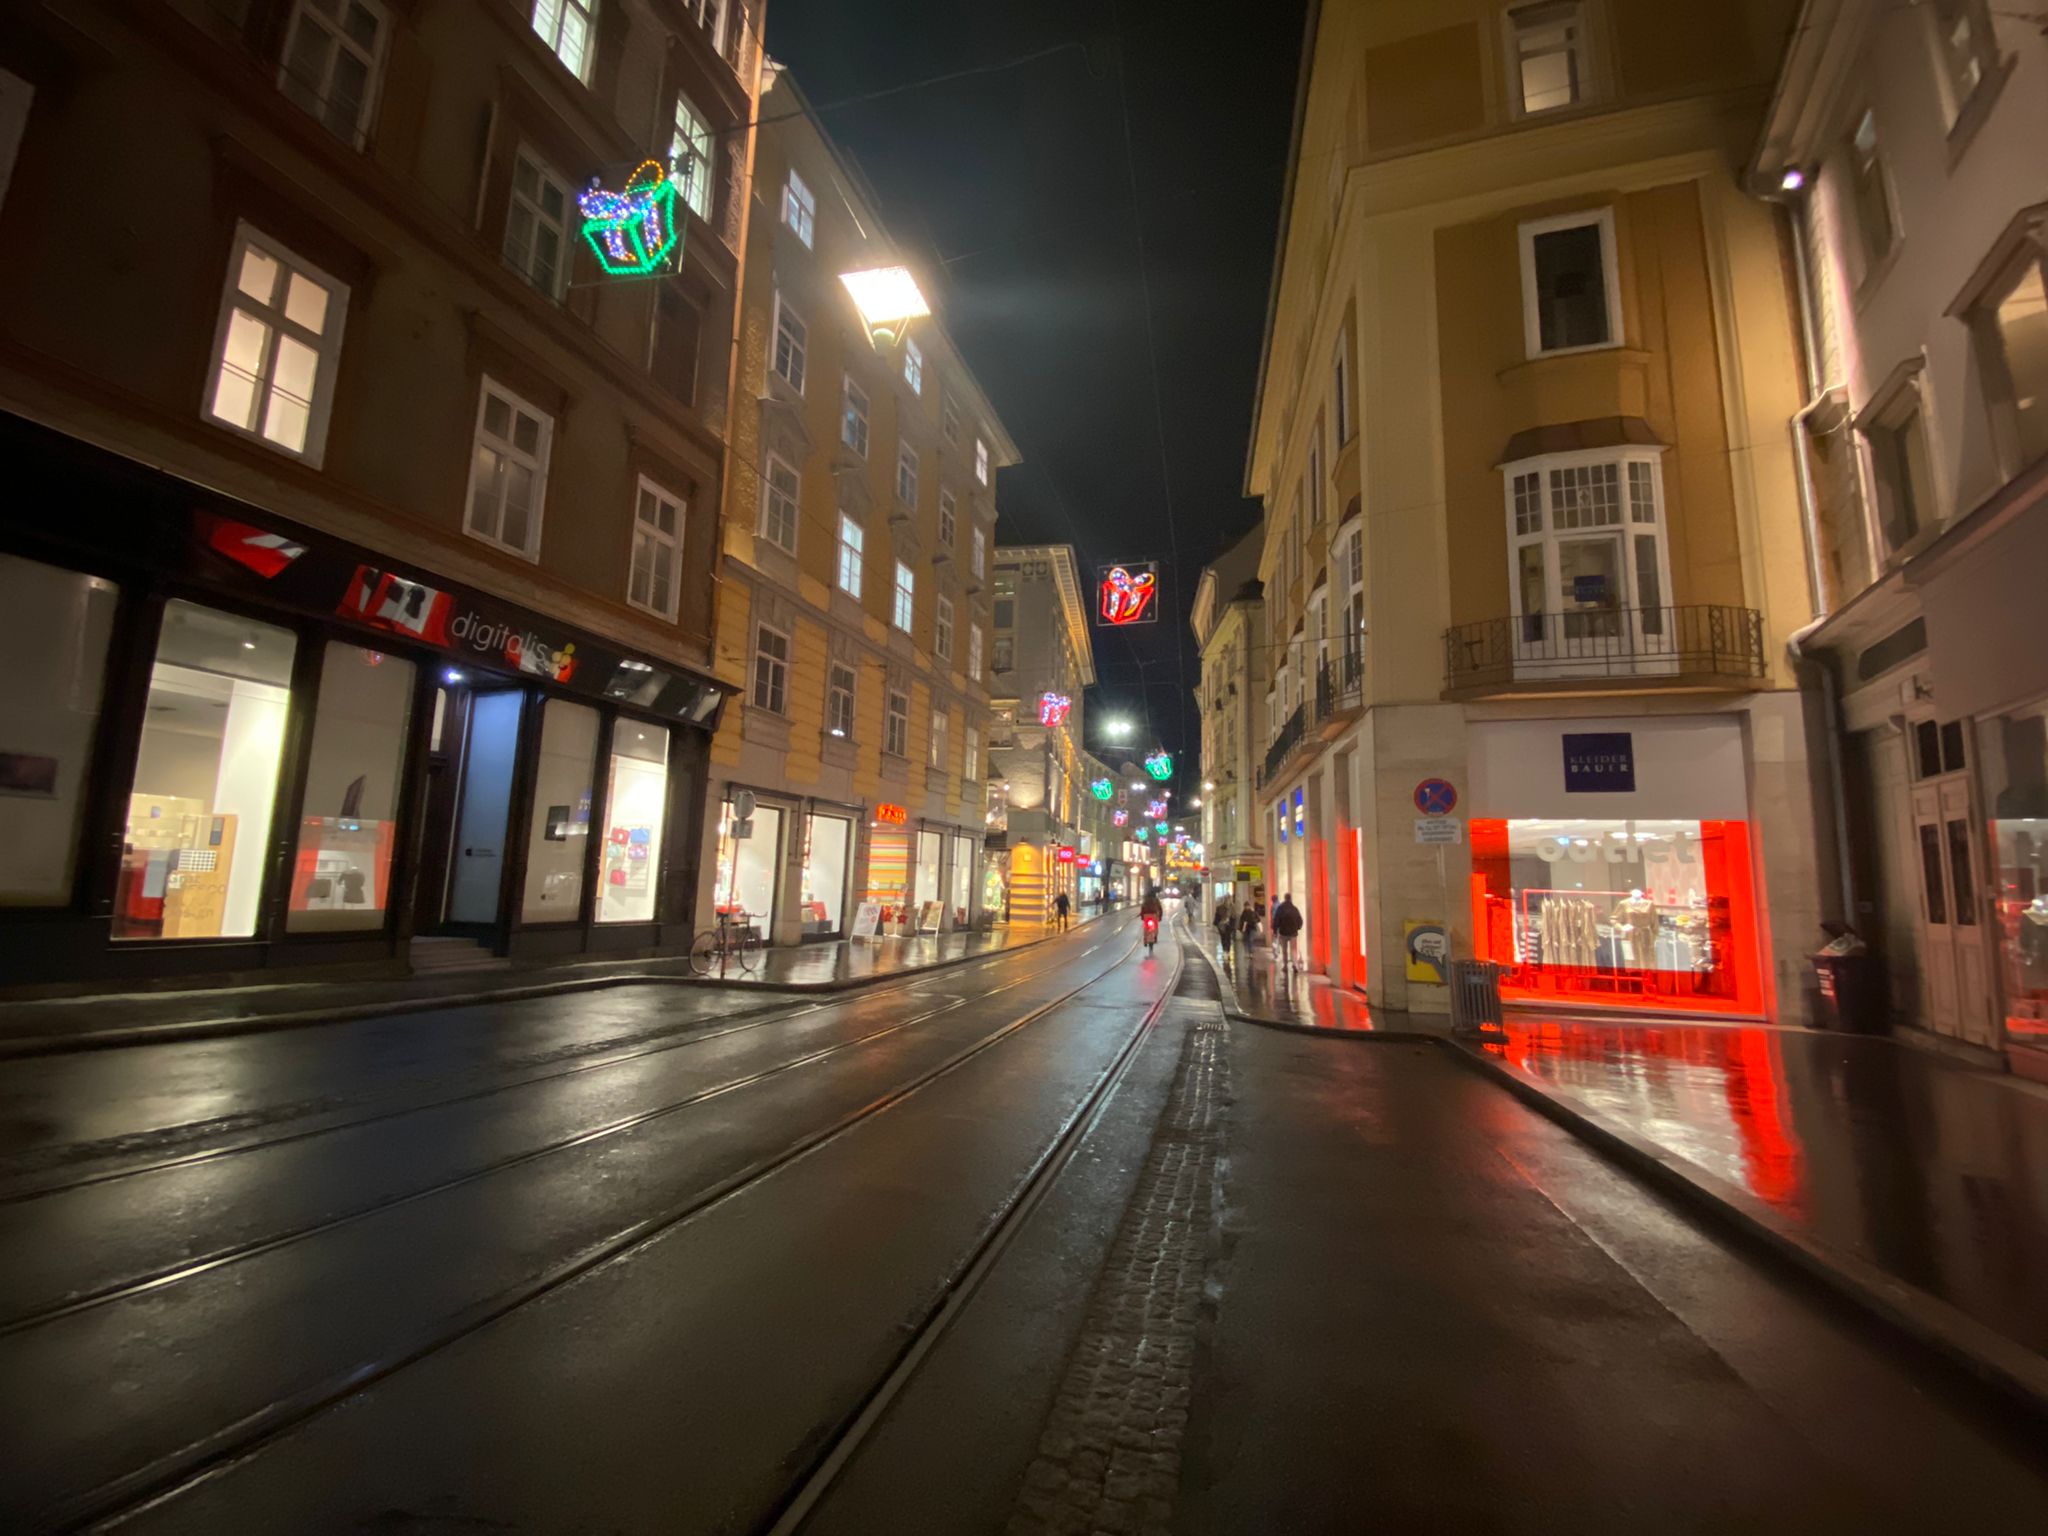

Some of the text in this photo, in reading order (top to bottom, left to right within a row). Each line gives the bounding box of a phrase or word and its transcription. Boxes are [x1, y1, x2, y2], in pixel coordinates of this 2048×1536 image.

[451, 611, 549, 662] digitalis
[1571, 764, 1629, 773] BAUER
[1536, 820, 1696, 864] outlet
